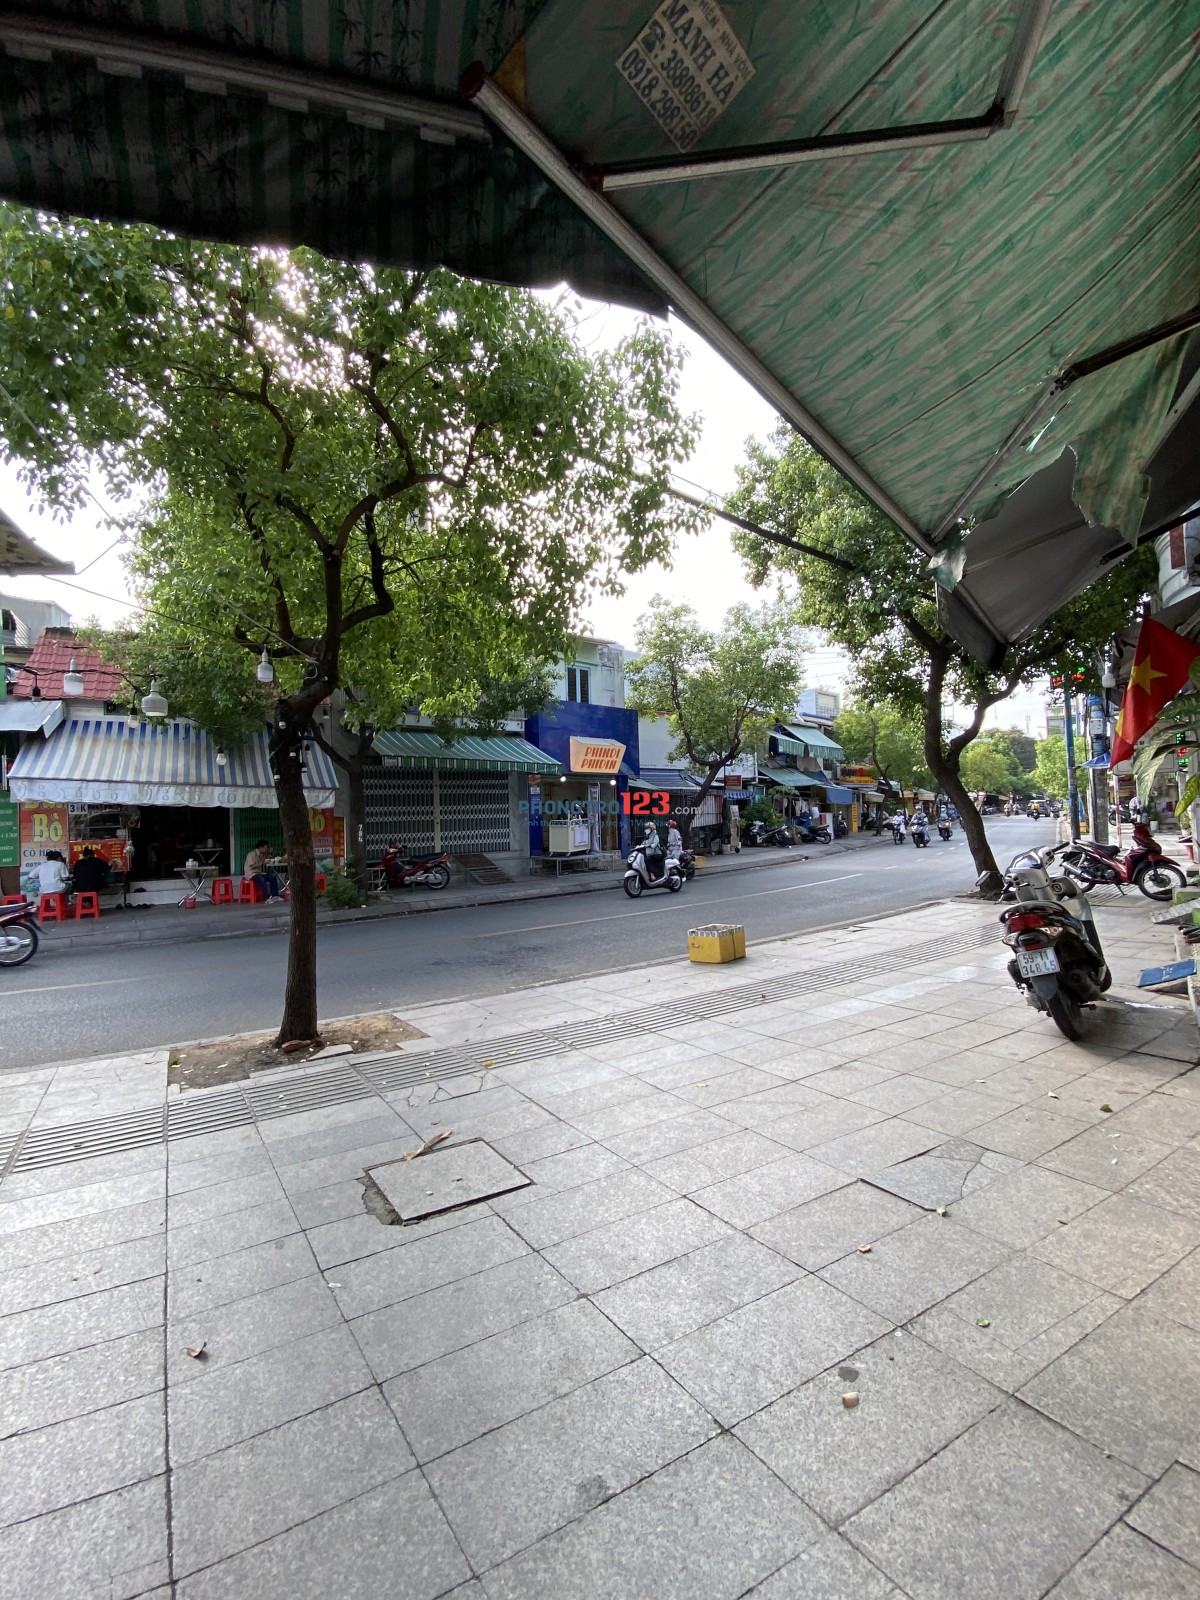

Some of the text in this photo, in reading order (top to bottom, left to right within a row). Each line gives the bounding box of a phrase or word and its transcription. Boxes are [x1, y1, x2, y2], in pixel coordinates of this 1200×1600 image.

[661, 0, 740, 107] MẠNH HÀ
[584, 746, 621, 759] PHINDI
[581, 758, 618, 770] PHIDIN
[31, 812, 63, 843] Bò
